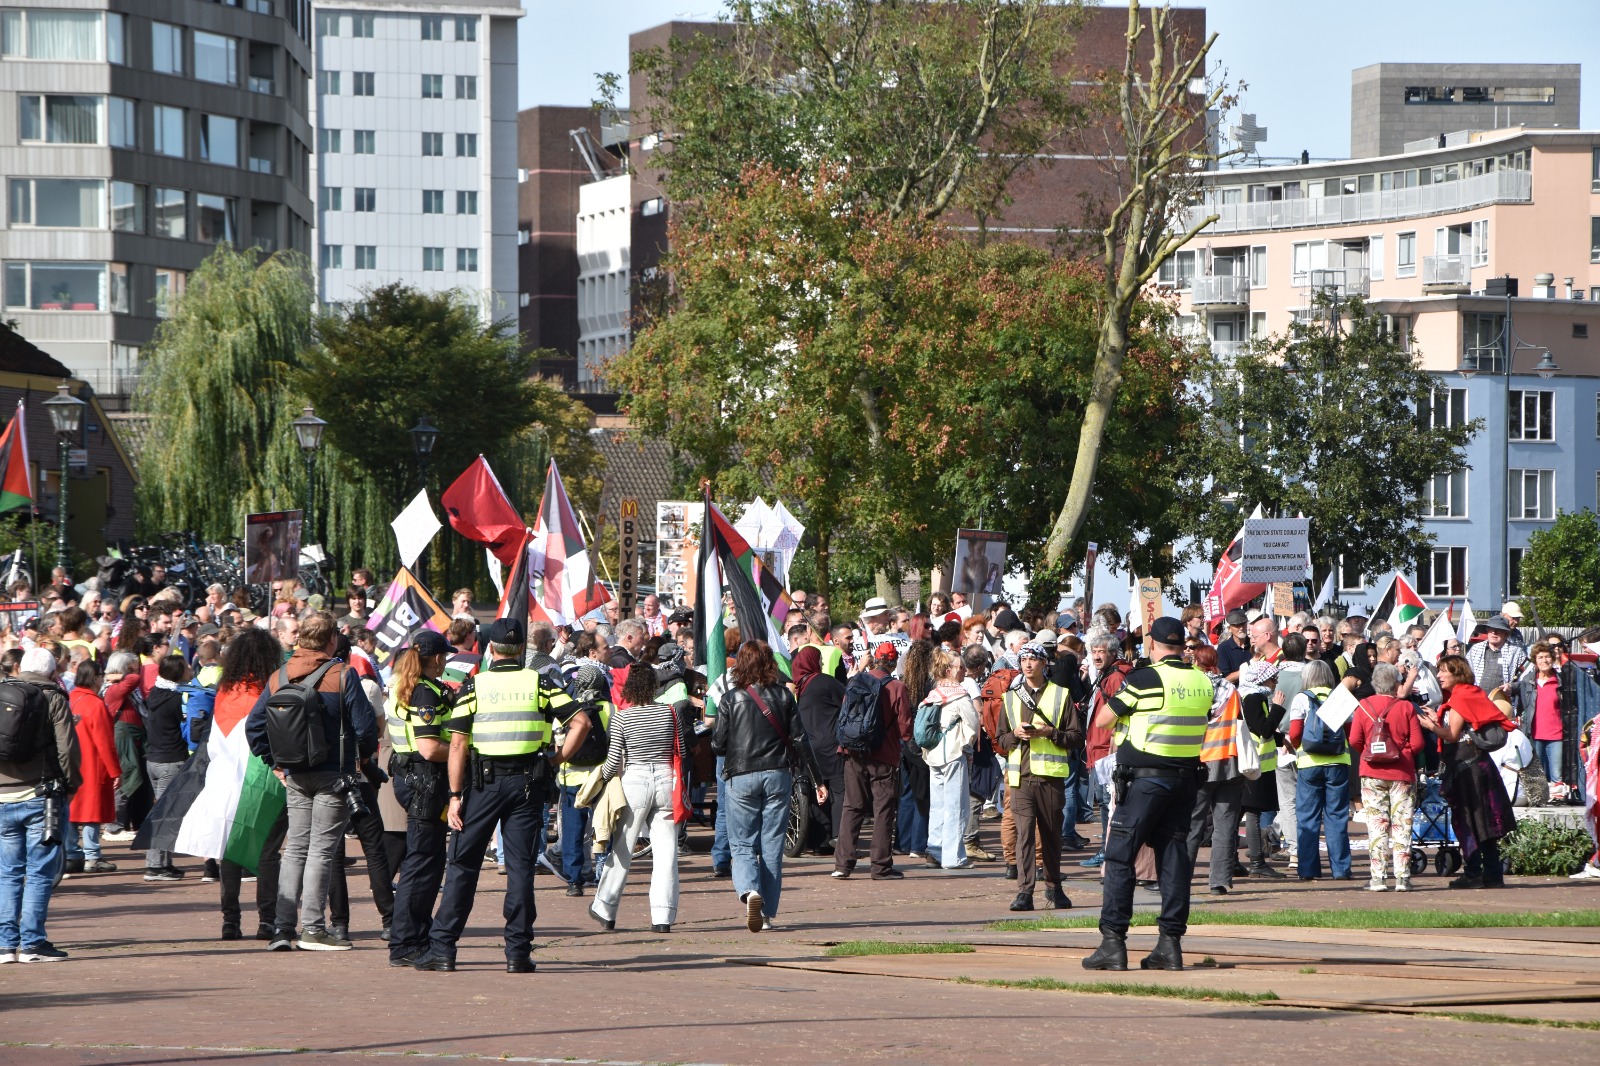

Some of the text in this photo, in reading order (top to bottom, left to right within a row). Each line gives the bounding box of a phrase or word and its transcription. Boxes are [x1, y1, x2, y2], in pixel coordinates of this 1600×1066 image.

[621, 520, 635, 620] BOYCOTT
[674, 560, 688, 608] OPEN
[1210, 595, 1221, 616] FREE
[869, 638, 908, 651] MUERS
